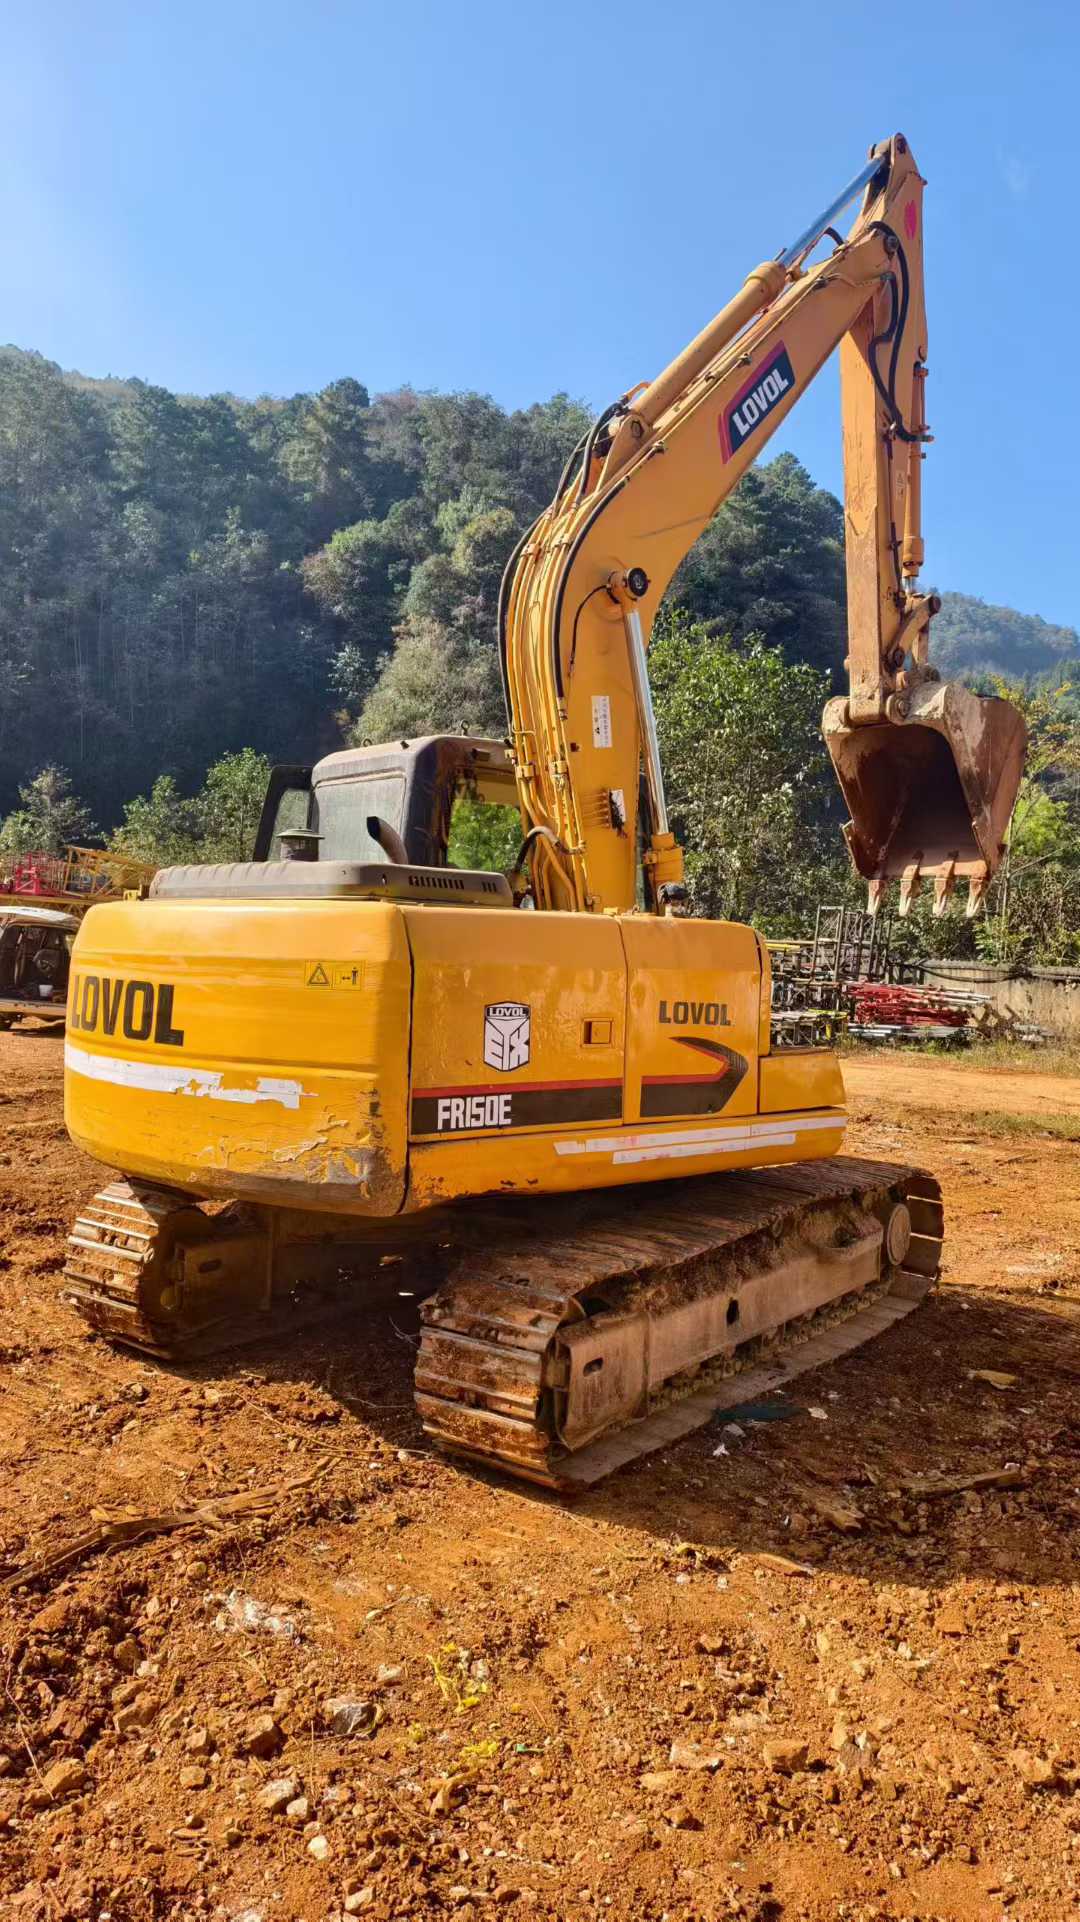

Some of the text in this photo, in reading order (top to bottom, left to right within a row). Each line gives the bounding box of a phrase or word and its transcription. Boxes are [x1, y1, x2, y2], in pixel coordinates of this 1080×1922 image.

[732, 369, 789, 436] LOVOL
[71, 975, 184, 1047] LOVOL
[489, 1007, 526, 1016] LOVOL
[658, 1000, 731, 1026] LOVOL
